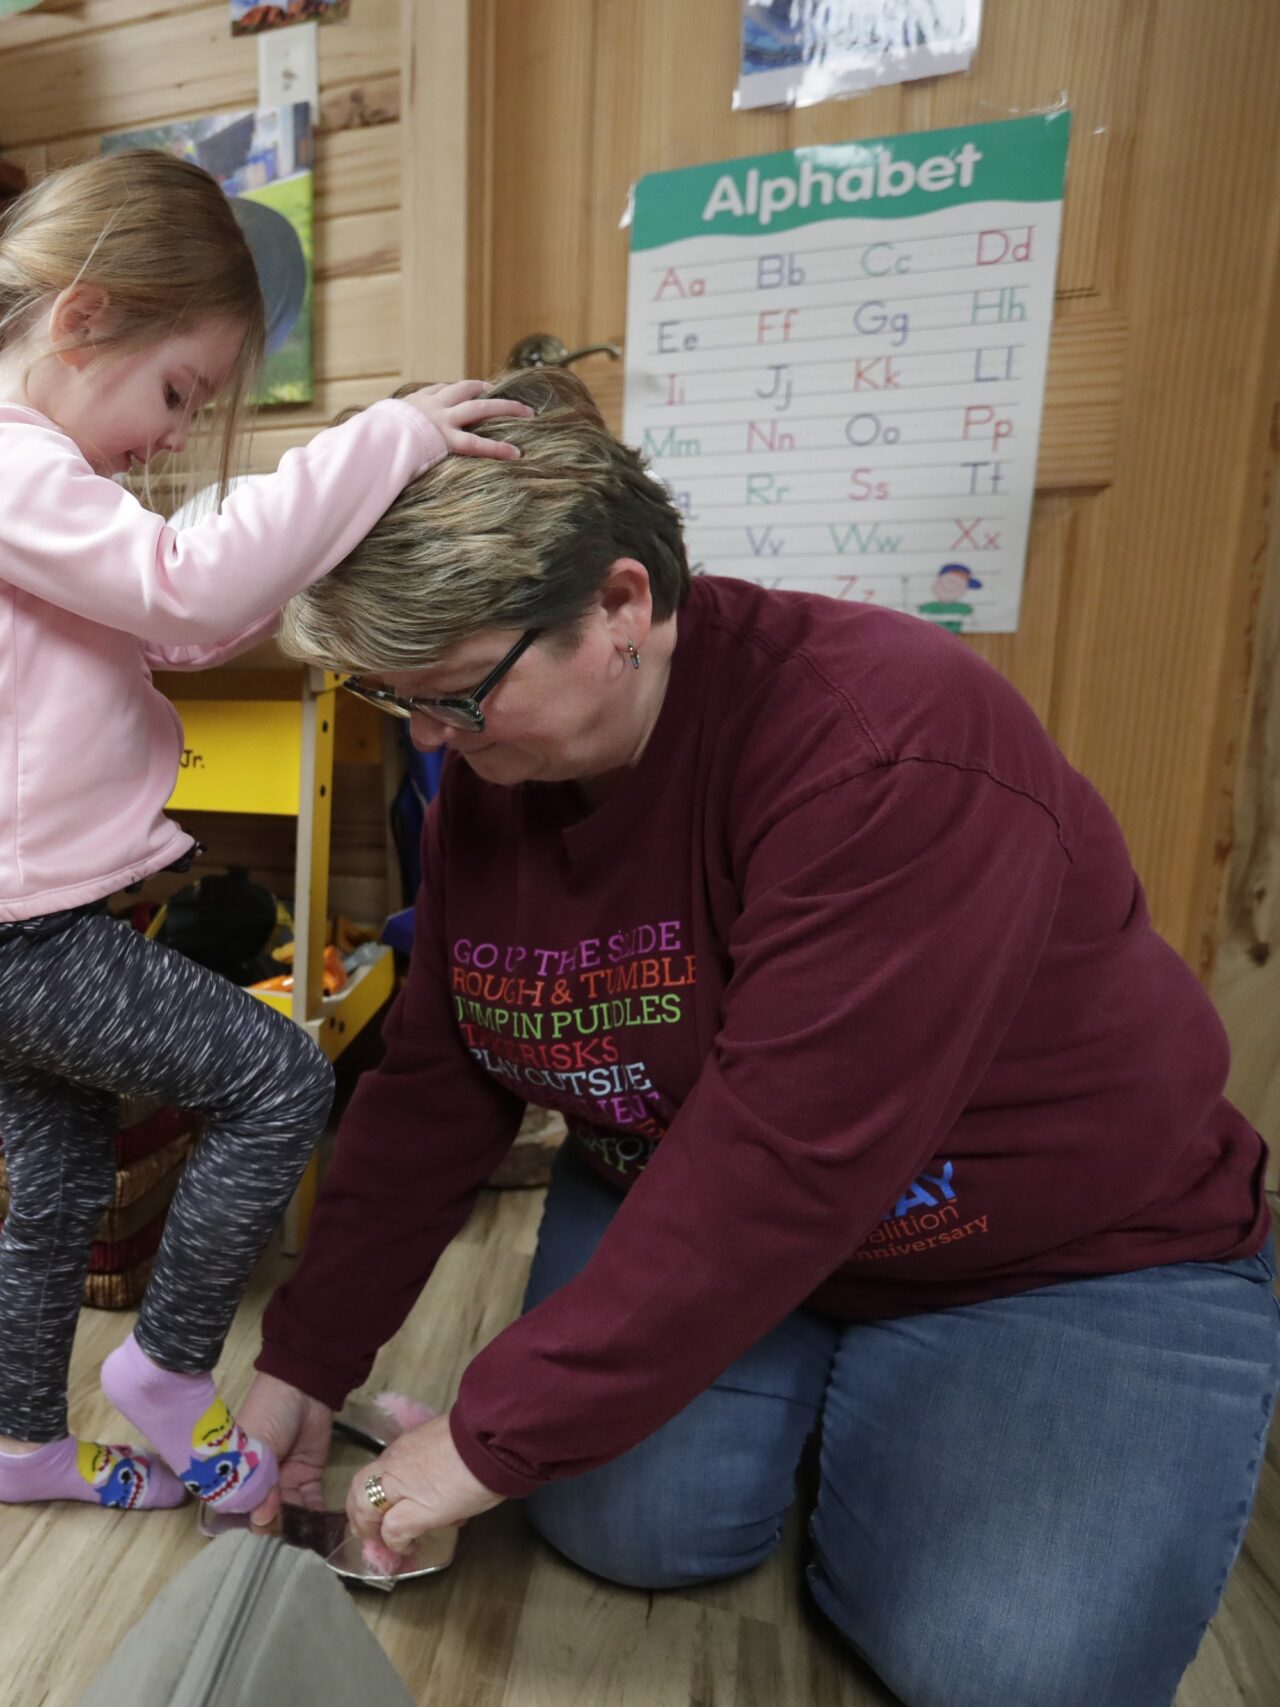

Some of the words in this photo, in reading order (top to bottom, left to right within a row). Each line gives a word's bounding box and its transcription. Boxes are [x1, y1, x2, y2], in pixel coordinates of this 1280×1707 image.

[702, 142, 983, 226] Alphabet
[654, 268, 706, 302] Aa
[756, 255, 807, 291] Bb
[860, 242, 912, 277] Cc
[976, 226, 1035, 267] Dd
[657, 319, 699, 354] Ee
[757, 309, 800, 344] Ff
[853, 300, 910, 346] Gg
[971, 287, 1028, 326] Hh
[665, 372, 686, 406] Ii
[755, 363, 794, 411] Jj
[852, 356, 901, 391] Kk
[641, 426, 701, 458] Mm
[746, 420, 796, 453] Nn
[844, 412, 901, 447] Oo
[962, 405, 1015, 452] Pp
[745, 472, 790, 505] Rr
[848, 468, 890, 501] Ss
[960, 461, 1006, 496] Tt
[745, 526, 785, 557] Vv
[828, 523, 902, 555] Ww
[950, 517, 1002, 551] Xx
[180, 748, 206, 769] Jr.
[453, 938, 499, 969] GO
[534, 938, 601, 977] THE
[451, 966, 545, 1007] ROUGH
[550, 978, 573, 1006] &
[512, 1011, 544, 1040] IN
[519, 1035, 621, 1071] RISKS
[524, 1062, 654, 1097] OUTSIE
[892, 1160, 957, 1218] AY
[854, 1215, 990, 1260] nniversary
[869, 1204, 959, 1244] alition
